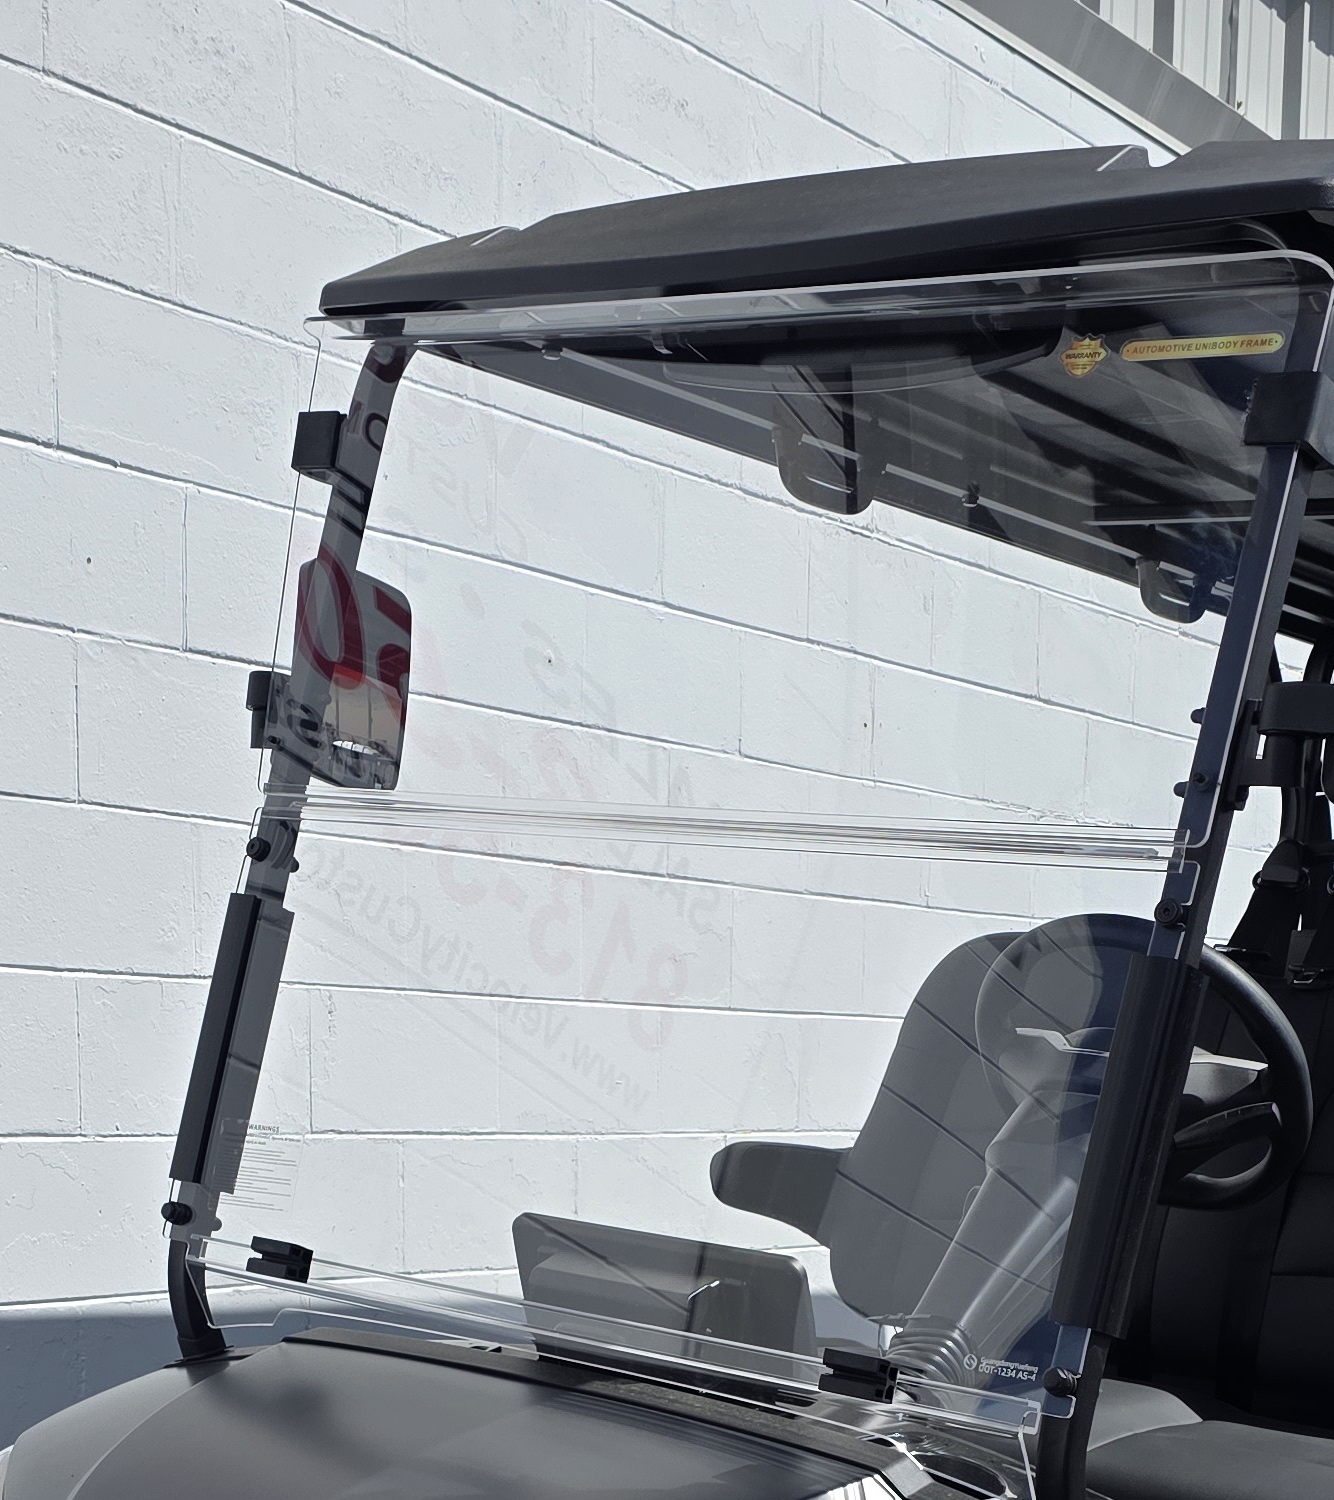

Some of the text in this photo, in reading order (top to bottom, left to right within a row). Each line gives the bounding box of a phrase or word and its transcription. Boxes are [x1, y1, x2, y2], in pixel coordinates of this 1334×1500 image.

[1065, 350, 1103, 360] WARRANTY
[1131, 337, 1274, 355] AUTOMOTIVE UNIBODY FRAME
[978, 1363, 1037, 1382] DOT-1234 AS-4
